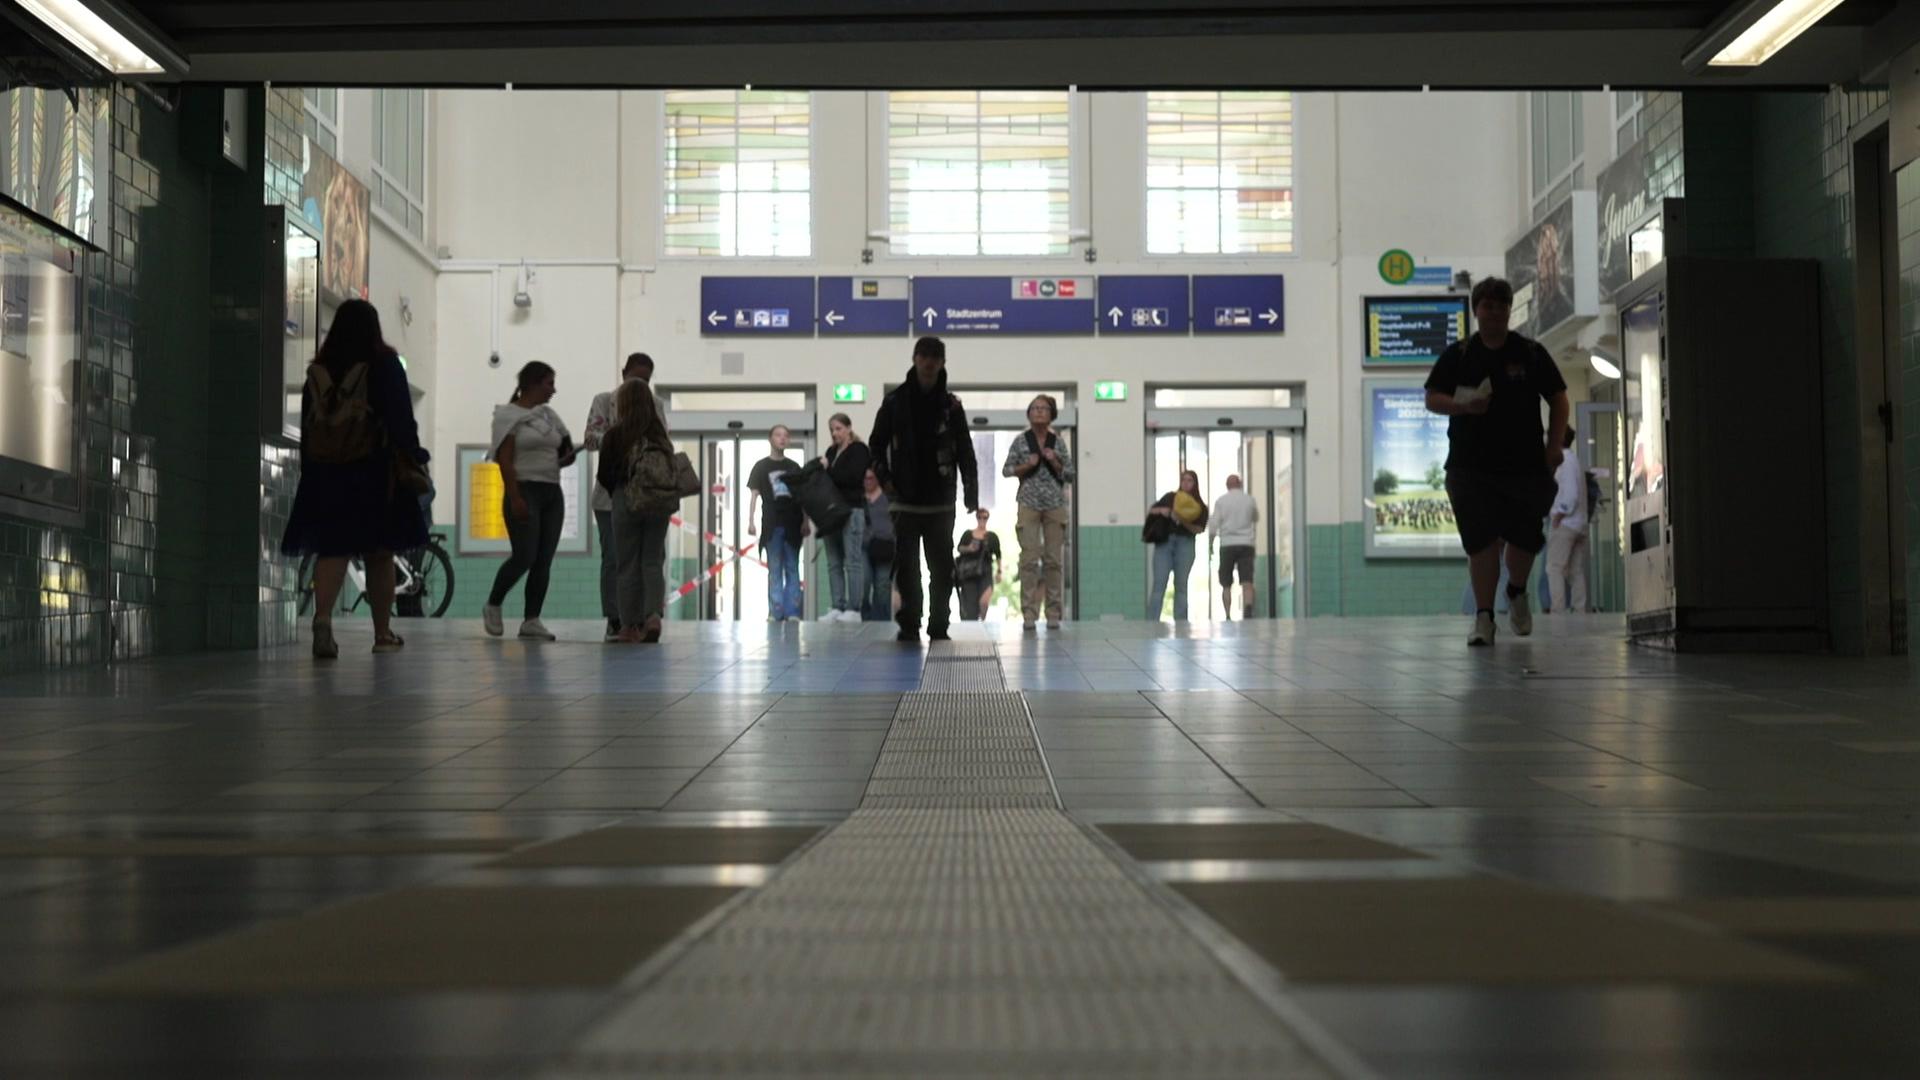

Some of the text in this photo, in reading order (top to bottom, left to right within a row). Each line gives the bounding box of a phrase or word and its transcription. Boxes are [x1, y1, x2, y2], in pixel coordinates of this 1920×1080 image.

[1389, 256, 1404, 278] H
[946, 308, 1003, 319] Stadtzentrum
[1383, 398, 1425, 409] Sinfonie
